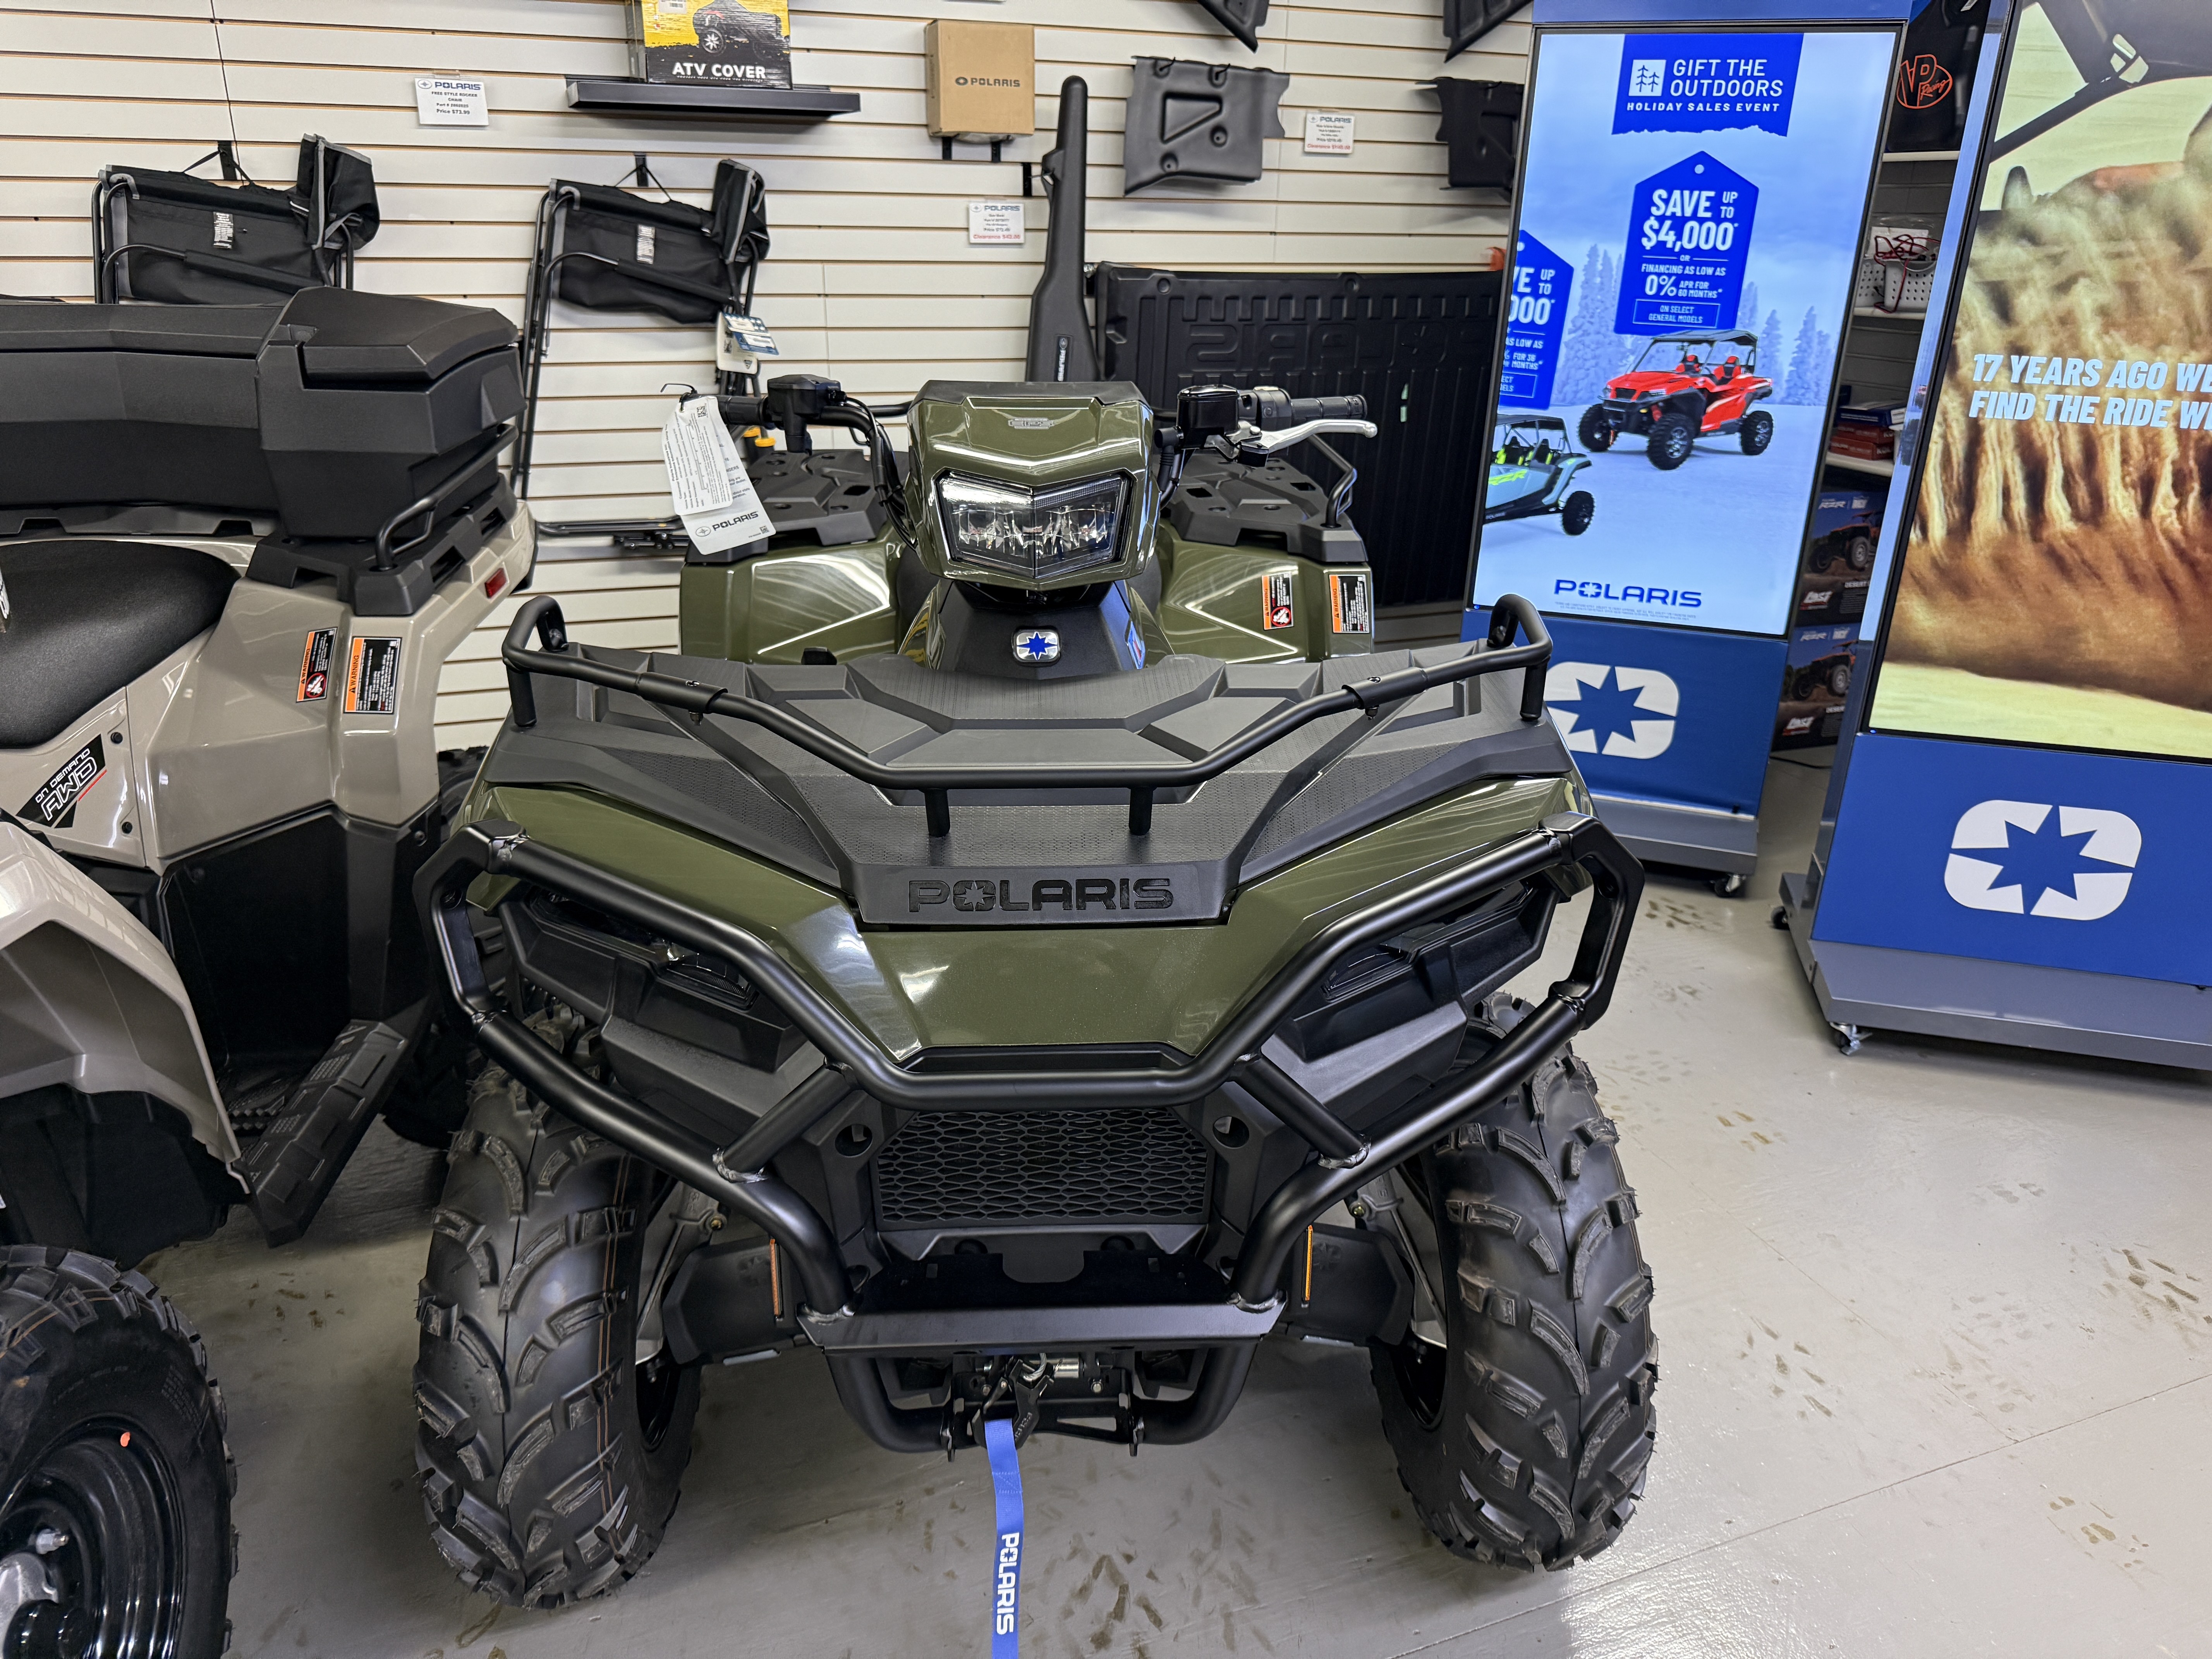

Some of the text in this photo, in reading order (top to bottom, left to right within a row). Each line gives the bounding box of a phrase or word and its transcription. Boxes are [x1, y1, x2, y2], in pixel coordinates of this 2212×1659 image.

[672, 62, 766, 78] ATV COVER
[1673, 59, 1767, 76] GIFT THE
[435, 82, 481, 90] POLARIS
[971, 77, 1020, 88] POLARIS
[1670, 80, 1783, 97] OUTDOORS
[1627, 103, 1779, 112] HOLIDAY SALES EVENT
[1650, 189, 1738, 218] SAVE UP
[1720, 206, 1734, 218] TO
[1540, 269, 1556, 281] UP
[1641, 263, 1726, 276] FINANCING AS LOW AS
[1538, 283, 1552, 295] TO
[1645, 275, 1677, 296] 0%
[1695, 281, 1709, 289] FOR
[1649, 313, 1703, 323] GENERAL MODELS
[1515, 338, 1533, 347] LOW
[1533, 339, 1544, 349] AS
[1513, 352, 1527, 361] FOR
[1973, 354, 2003, 382] 17
[2010, 355, 2103, 387] YEARS
[2106, 360, 2168, 390] AGO
[1969, 390, 2036, 420] FIND
[2044, 393, 2100, 424] THE
[2103, 397, 2173, 428] RIDE
[712, 511, 758, 531] POLARIS
[1554, 579, 1702, 608] POLARIS
[302, 648, 310, 677] WARNING
[350, 655, 359, 687] WARNING
[35, 748, 90, 803] ON DEMAND
[41, 757, 97, 821] AWD
[909, 878, 1173, 912] POLARIS
[996, 1532, 1020, 1636] POLARIS
